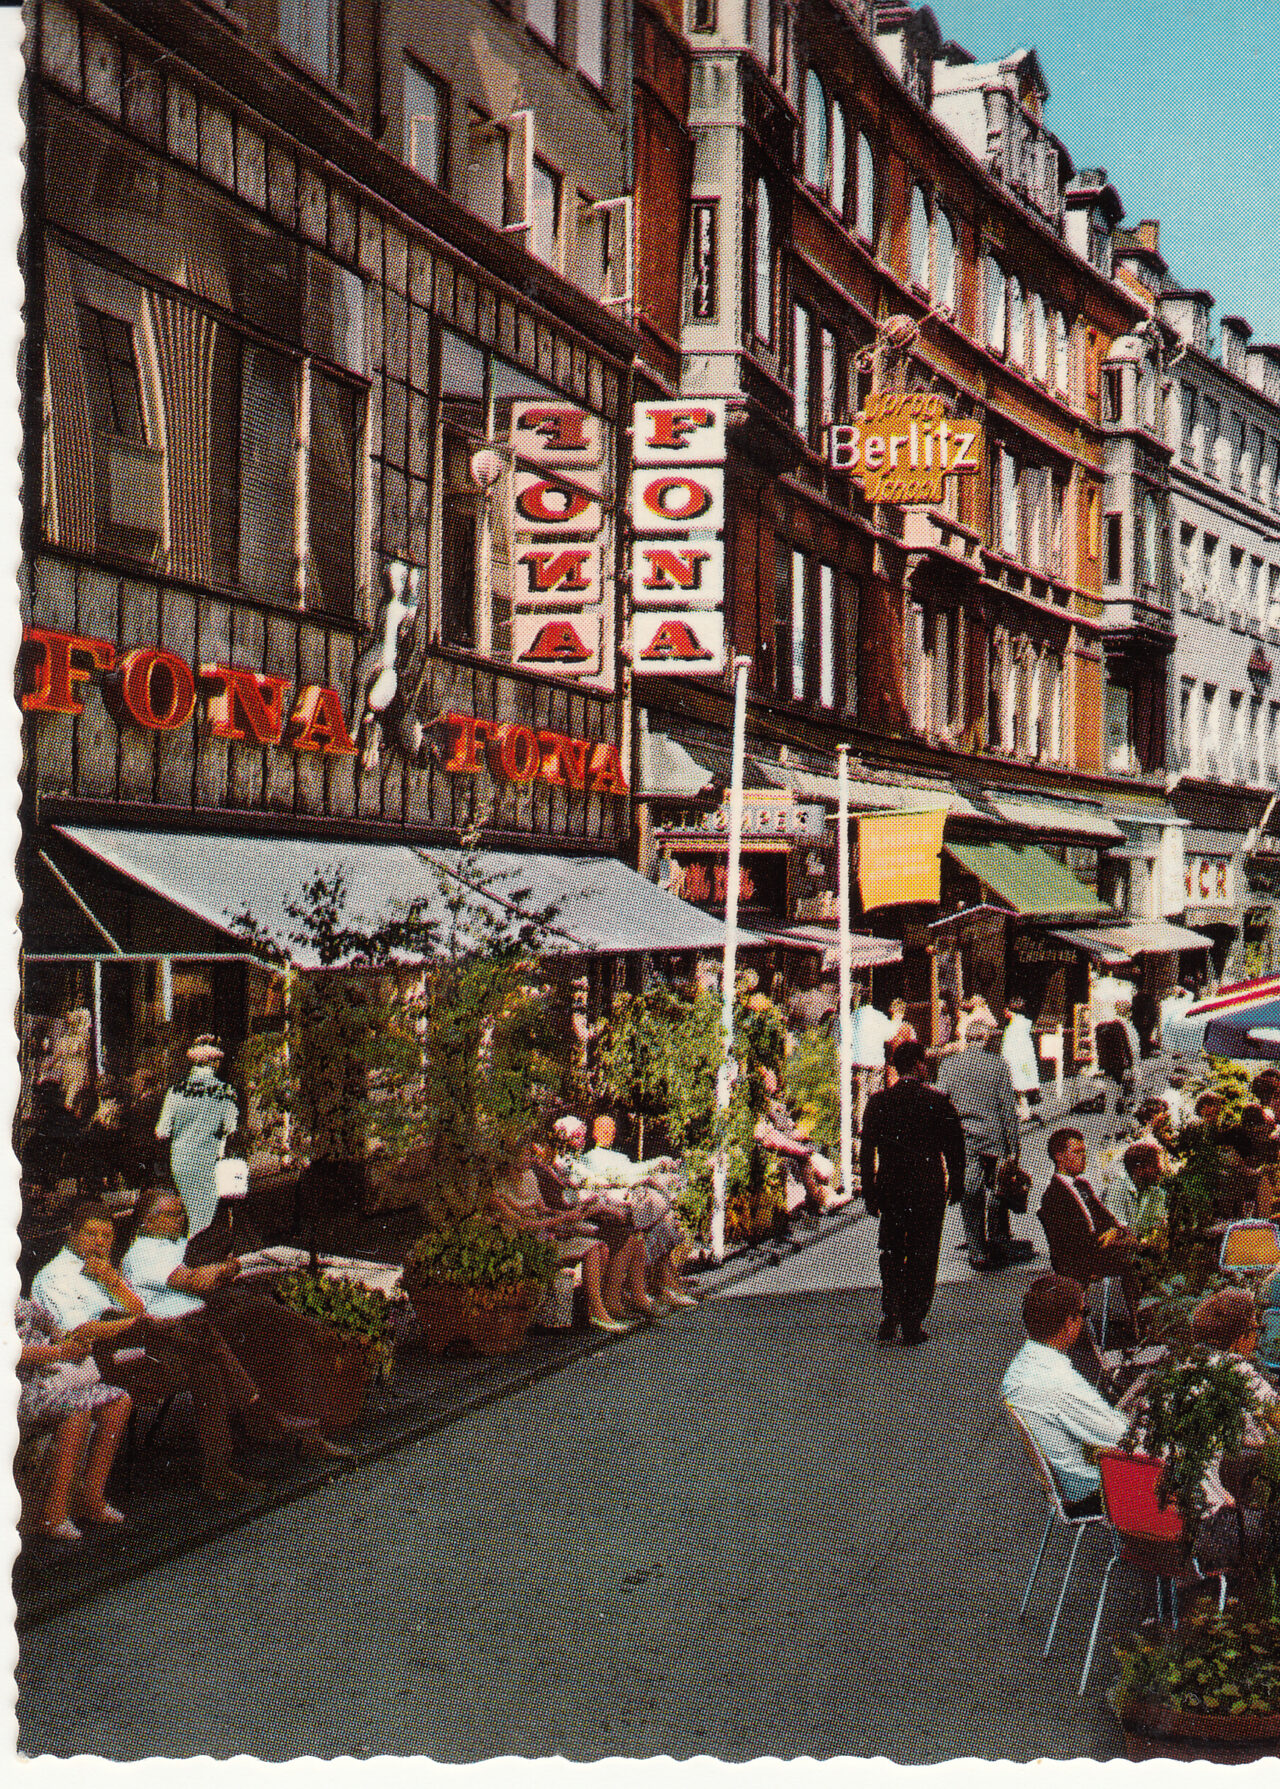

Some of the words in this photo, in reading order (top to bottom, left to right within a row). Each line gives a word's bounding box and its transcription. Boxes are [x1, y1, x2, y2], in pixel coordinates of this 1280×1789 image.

[829, 420, 979, 471] Berlitz
[640, 406, 718, 664] FONA
[22, 627, 358, 756] FONA
[445, 713, 631, 796] FONA
